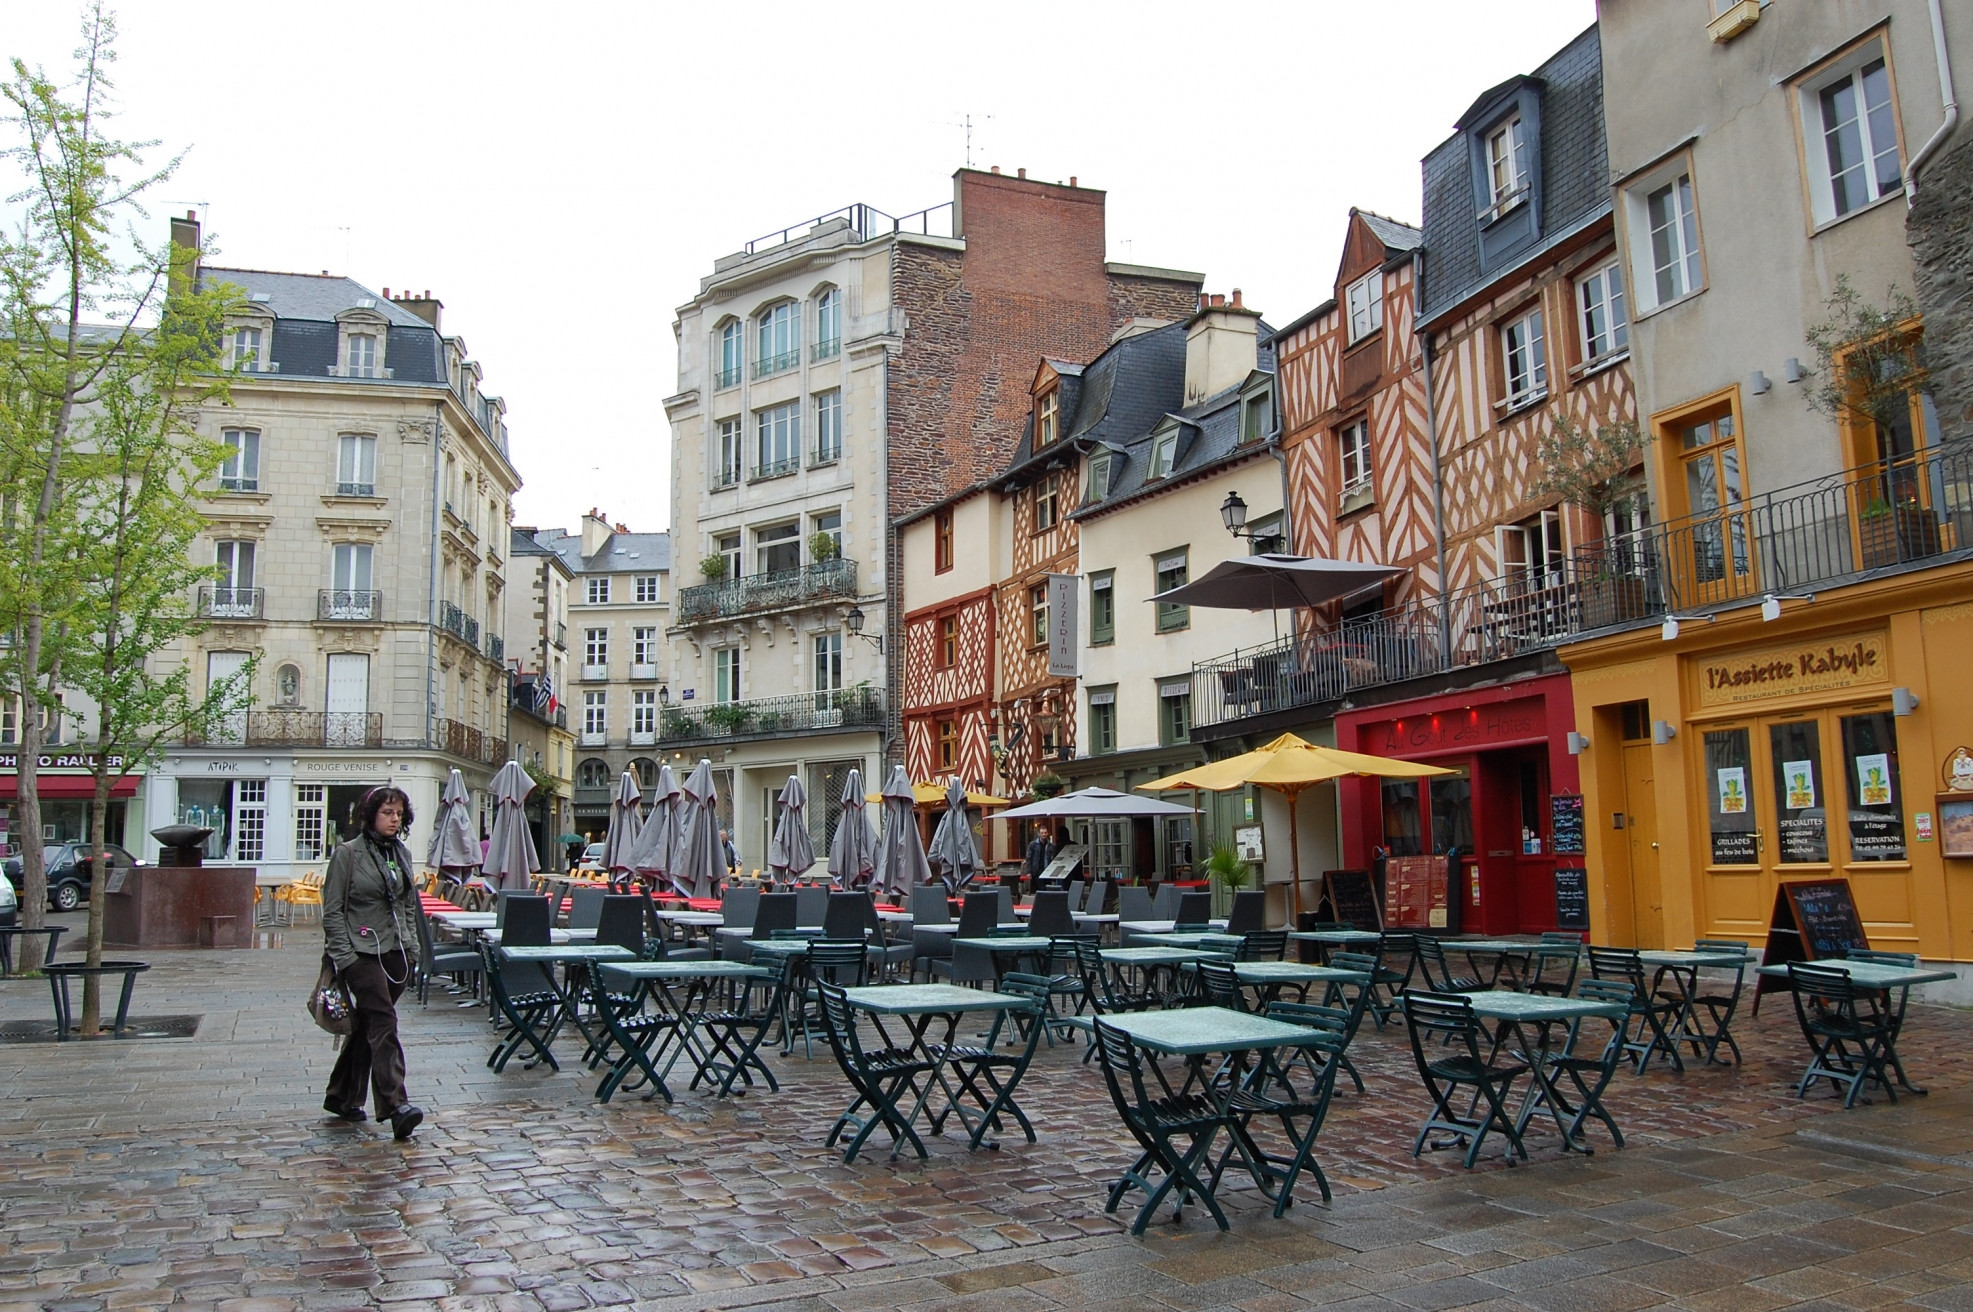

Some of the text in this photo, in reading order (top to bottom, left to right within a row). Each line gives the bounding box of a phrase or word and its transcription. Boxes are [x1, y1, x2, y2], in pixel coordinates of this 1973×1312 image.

[1706, 642, 1877, 689] l'Assiette Kabyle
[56, 755, 123, 767] RALLER
[307, 763, 379, 772] ROUGE VENISE
[1717, 838, 1751, 846] GRILLADES
